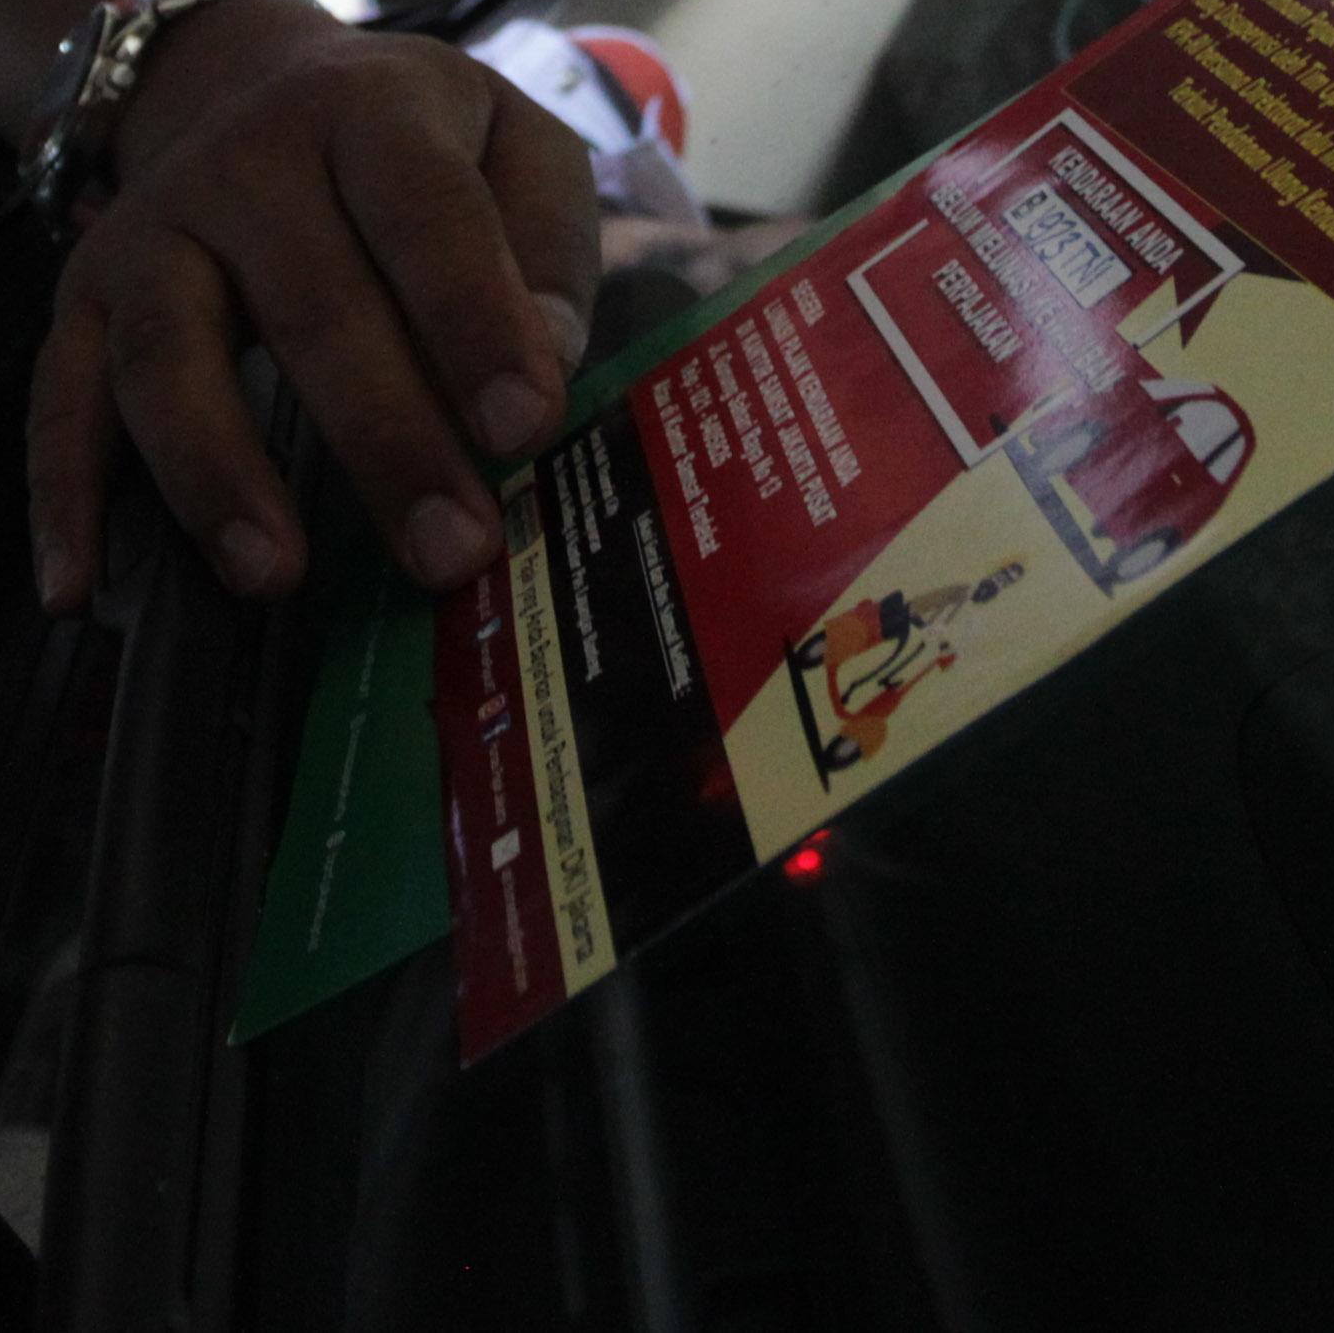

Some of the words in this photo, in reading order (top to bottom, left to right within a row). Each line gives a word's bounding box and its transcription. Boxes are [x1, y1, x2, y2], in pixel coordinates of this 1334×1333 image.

[1238, 77, 1313, 137] Direktorat
[1269, 46, 1310, 75] oleh
[1296, 60, 1330, 92] Tim
[1169, 76, 1217, 120] Terkait
[1201, 106, 1273, 170] Pendataan
[1259, 157, 1310, 206] Ulang
[927, 178, 986, 235] BELUM
[964, 221, 1045, 303] MELUNASI
[1047, 144, 1145, 234] KENDARAAN
[1123, 220, 1184, 274] ANDA
[791, 278, 824, 325] SEGERA
[930, 257, 1025, 364] PERPAJAKAN
[742, 332, 774, 381] KANTOR
[758, 374, 794, 424] SAMSAT
[777, 425, 816, 482] JAKARTA
[800, 475, 837, 525] PUSAT
[781, 334, 812, 379] PAJAK
[798, 372, 845, 448] KENDARAAN
[828, 443, 861, 486] ANDA
[759, 475, 783, 499] 13
[560, 848, 588, 892] DKI
